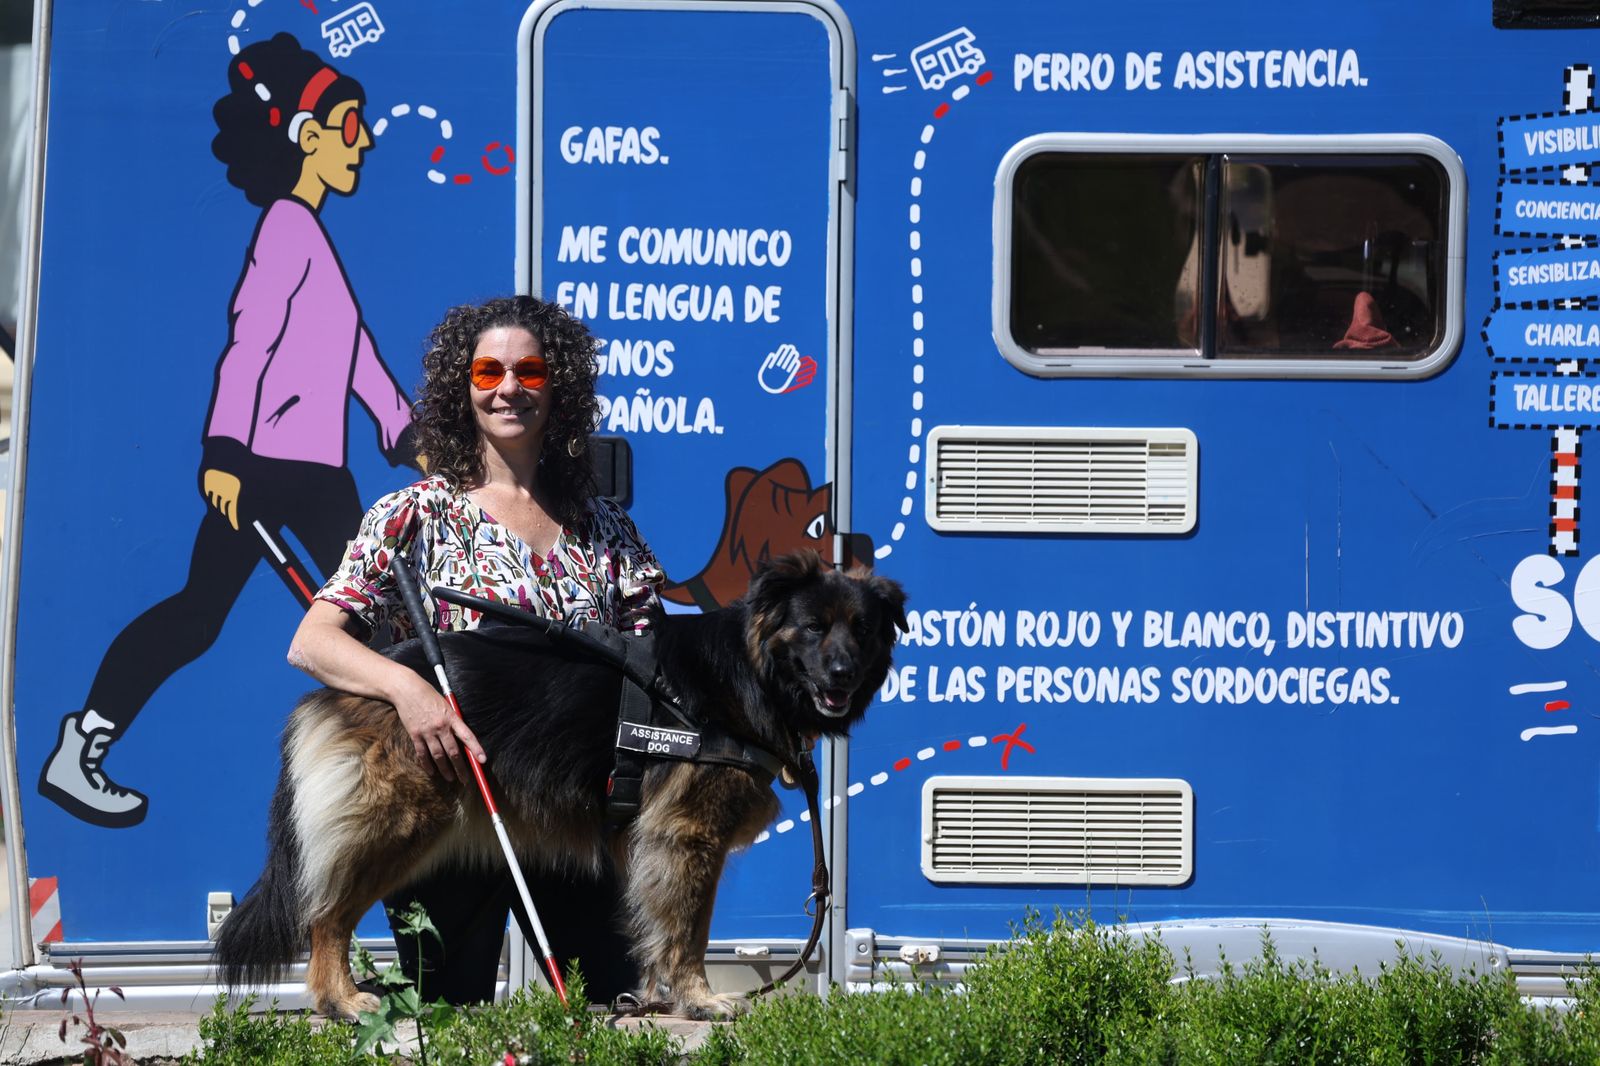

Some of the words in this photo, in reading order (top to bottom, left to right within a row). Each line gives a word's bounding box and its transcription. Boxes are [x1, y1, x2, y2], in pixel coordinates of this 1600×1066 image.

[1015, 53, 1114, 91] PERRO
[1126, 52, 1163, 90] DE
[1174, 49, 1368, 89] ASISTENCIA.
[560, 126, 669, 165] GAFAS.
[1524, 125, 1600, 156] VISIBILI
[557, 225, 607, 263] ME
[618, 226, 792, 267] COMUNICO
[1508, 260, 1600, 286] SENSIBLIZA
[556, 281, 599, 320] EN
[608, 282, 734, 323] LENGUA
[744, 285, 782, 323] DE
[1525, 323, 1600, 347] CHARLA
[1513, 384, 1600, 412] TALLERE
[894, 601, 1006, 647] ASTÓN
[1016, 610, 1101, 648] ROJO
[1111, 611, 1133, 648] Y
[1143, 610, 1276, 657] BLANCO,
[1287, 611, 1464, 649] DISTINTIVO
[880, 665, 918, 703] DE
[927, 665, 987, 703] LAS
[996, 666, 1162, 704] PERSONAS
[1171, 667, 1400, 705] SORDOCIEGAS.
[630, 727, 694, 745] ASSISTANCE
[647, 741, 670, 753] DOG
